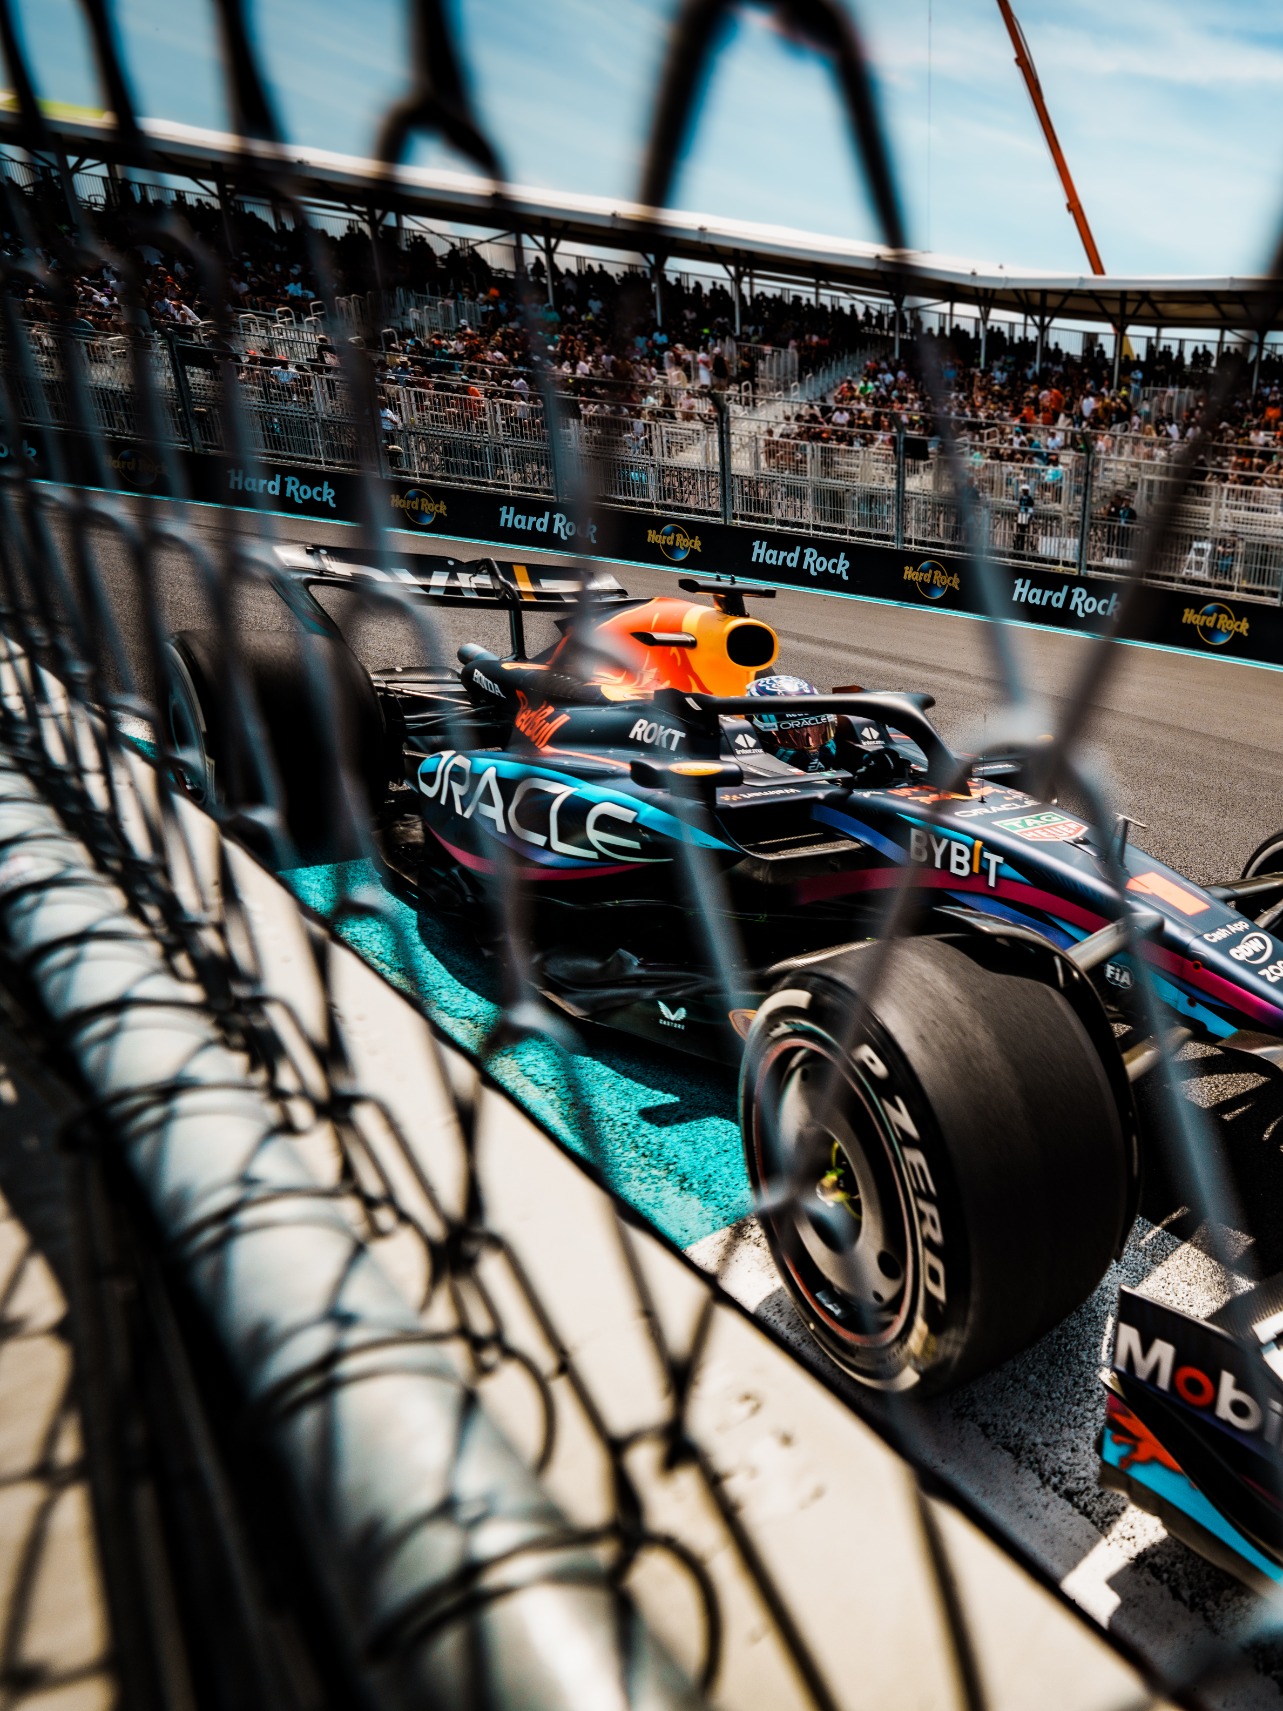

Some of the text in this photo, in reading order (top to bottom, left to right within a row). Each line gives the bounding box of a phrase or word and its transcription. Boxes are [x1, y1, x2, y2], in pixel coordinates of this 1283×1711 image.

[227, 469, 336, 508] Hard Rock
[390, 494, 448, 517] Hard Rock
[499, 505, 550, 533] Hard
[646, 529, 703, 552] Hard Rock
[751, 540, 850, 581] Hard Rock
[903, 565, 961, 592] Hard Rock
[1012, 578, 1122, 621] Hard Rock
[1182, 606, 1250, 638] Hard Rock
[628, 718, 686, 752] ROKT
[779, 714, 830, 730] ORACLE
[417, 749, 674, 864] ORACLE
[954, 799, 1042, 818] ORACLE
[1003, 813, 1061, 829] TAG
[1022, 821, 1080, 839] HEUER
[910, 827, 1004, 888] BYBIT
[1203, 920, 1250, 943] Cash App
[1229, 937, 1267, 961] CDW
[850, 1043, 947, 1303] P ZERO
